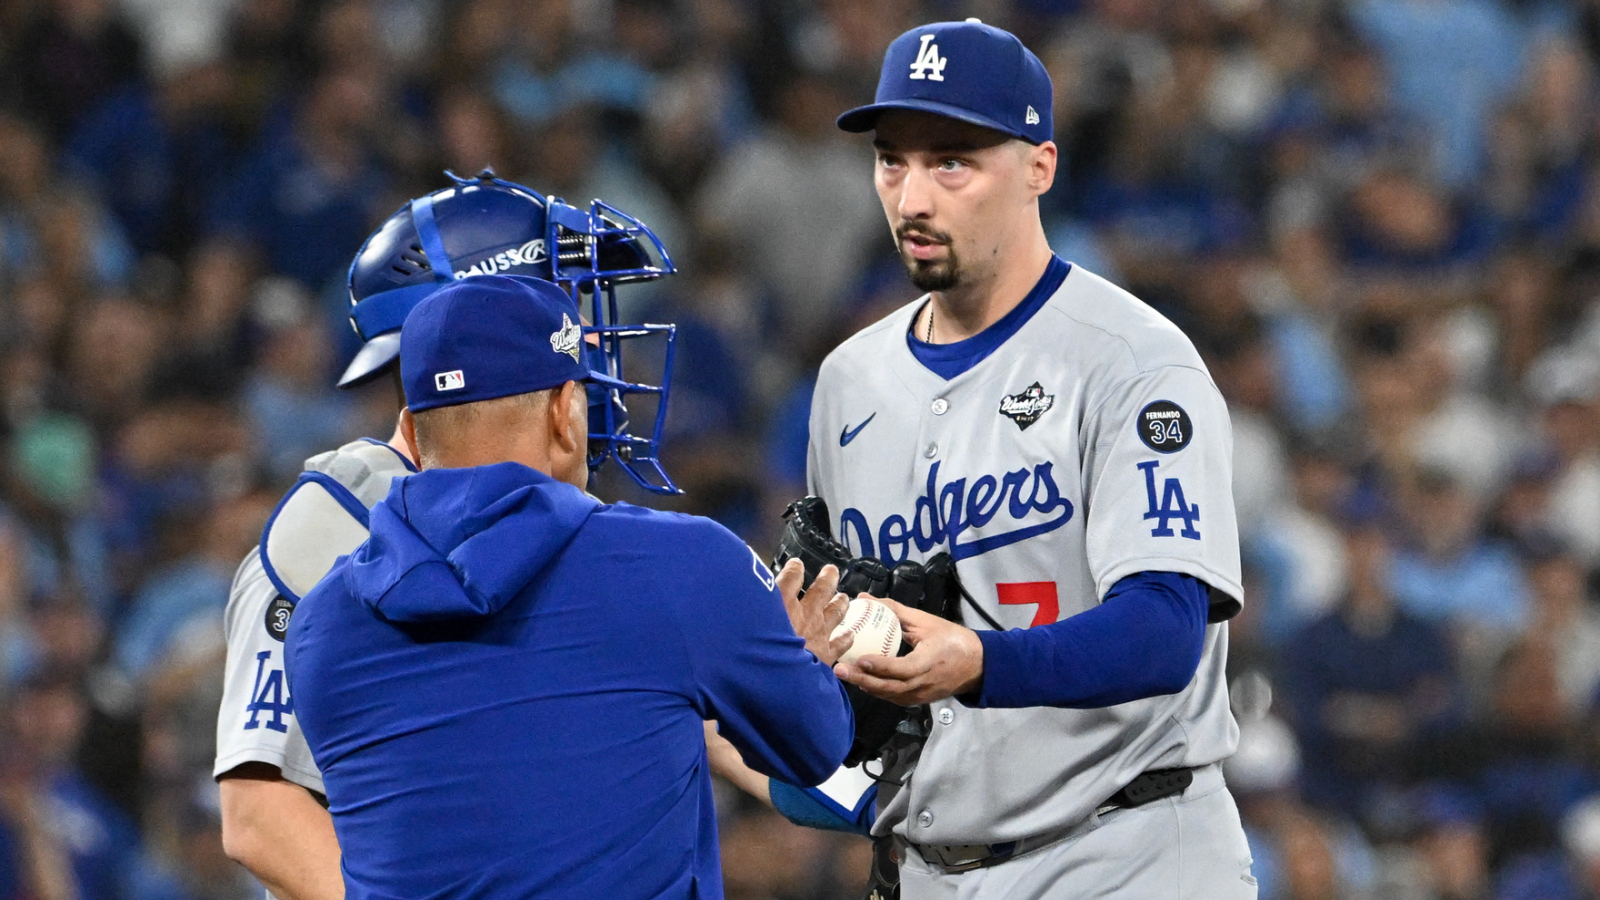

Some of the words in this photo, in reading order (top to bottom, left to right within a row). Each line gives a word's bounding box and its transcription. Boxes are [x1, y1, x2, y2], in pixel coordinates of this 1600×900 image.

[909, 34, 947, 82] LA
[1146, 411, 1181, 420] FERNANDO
[1149, 420, 1182, 444] 34
[841, 460, 1074, 569] Dodgers
[1136, 460, 1201, 540] LA
[996, 580, 1060, 628] 7
[243, 650, 293, 734] LA
